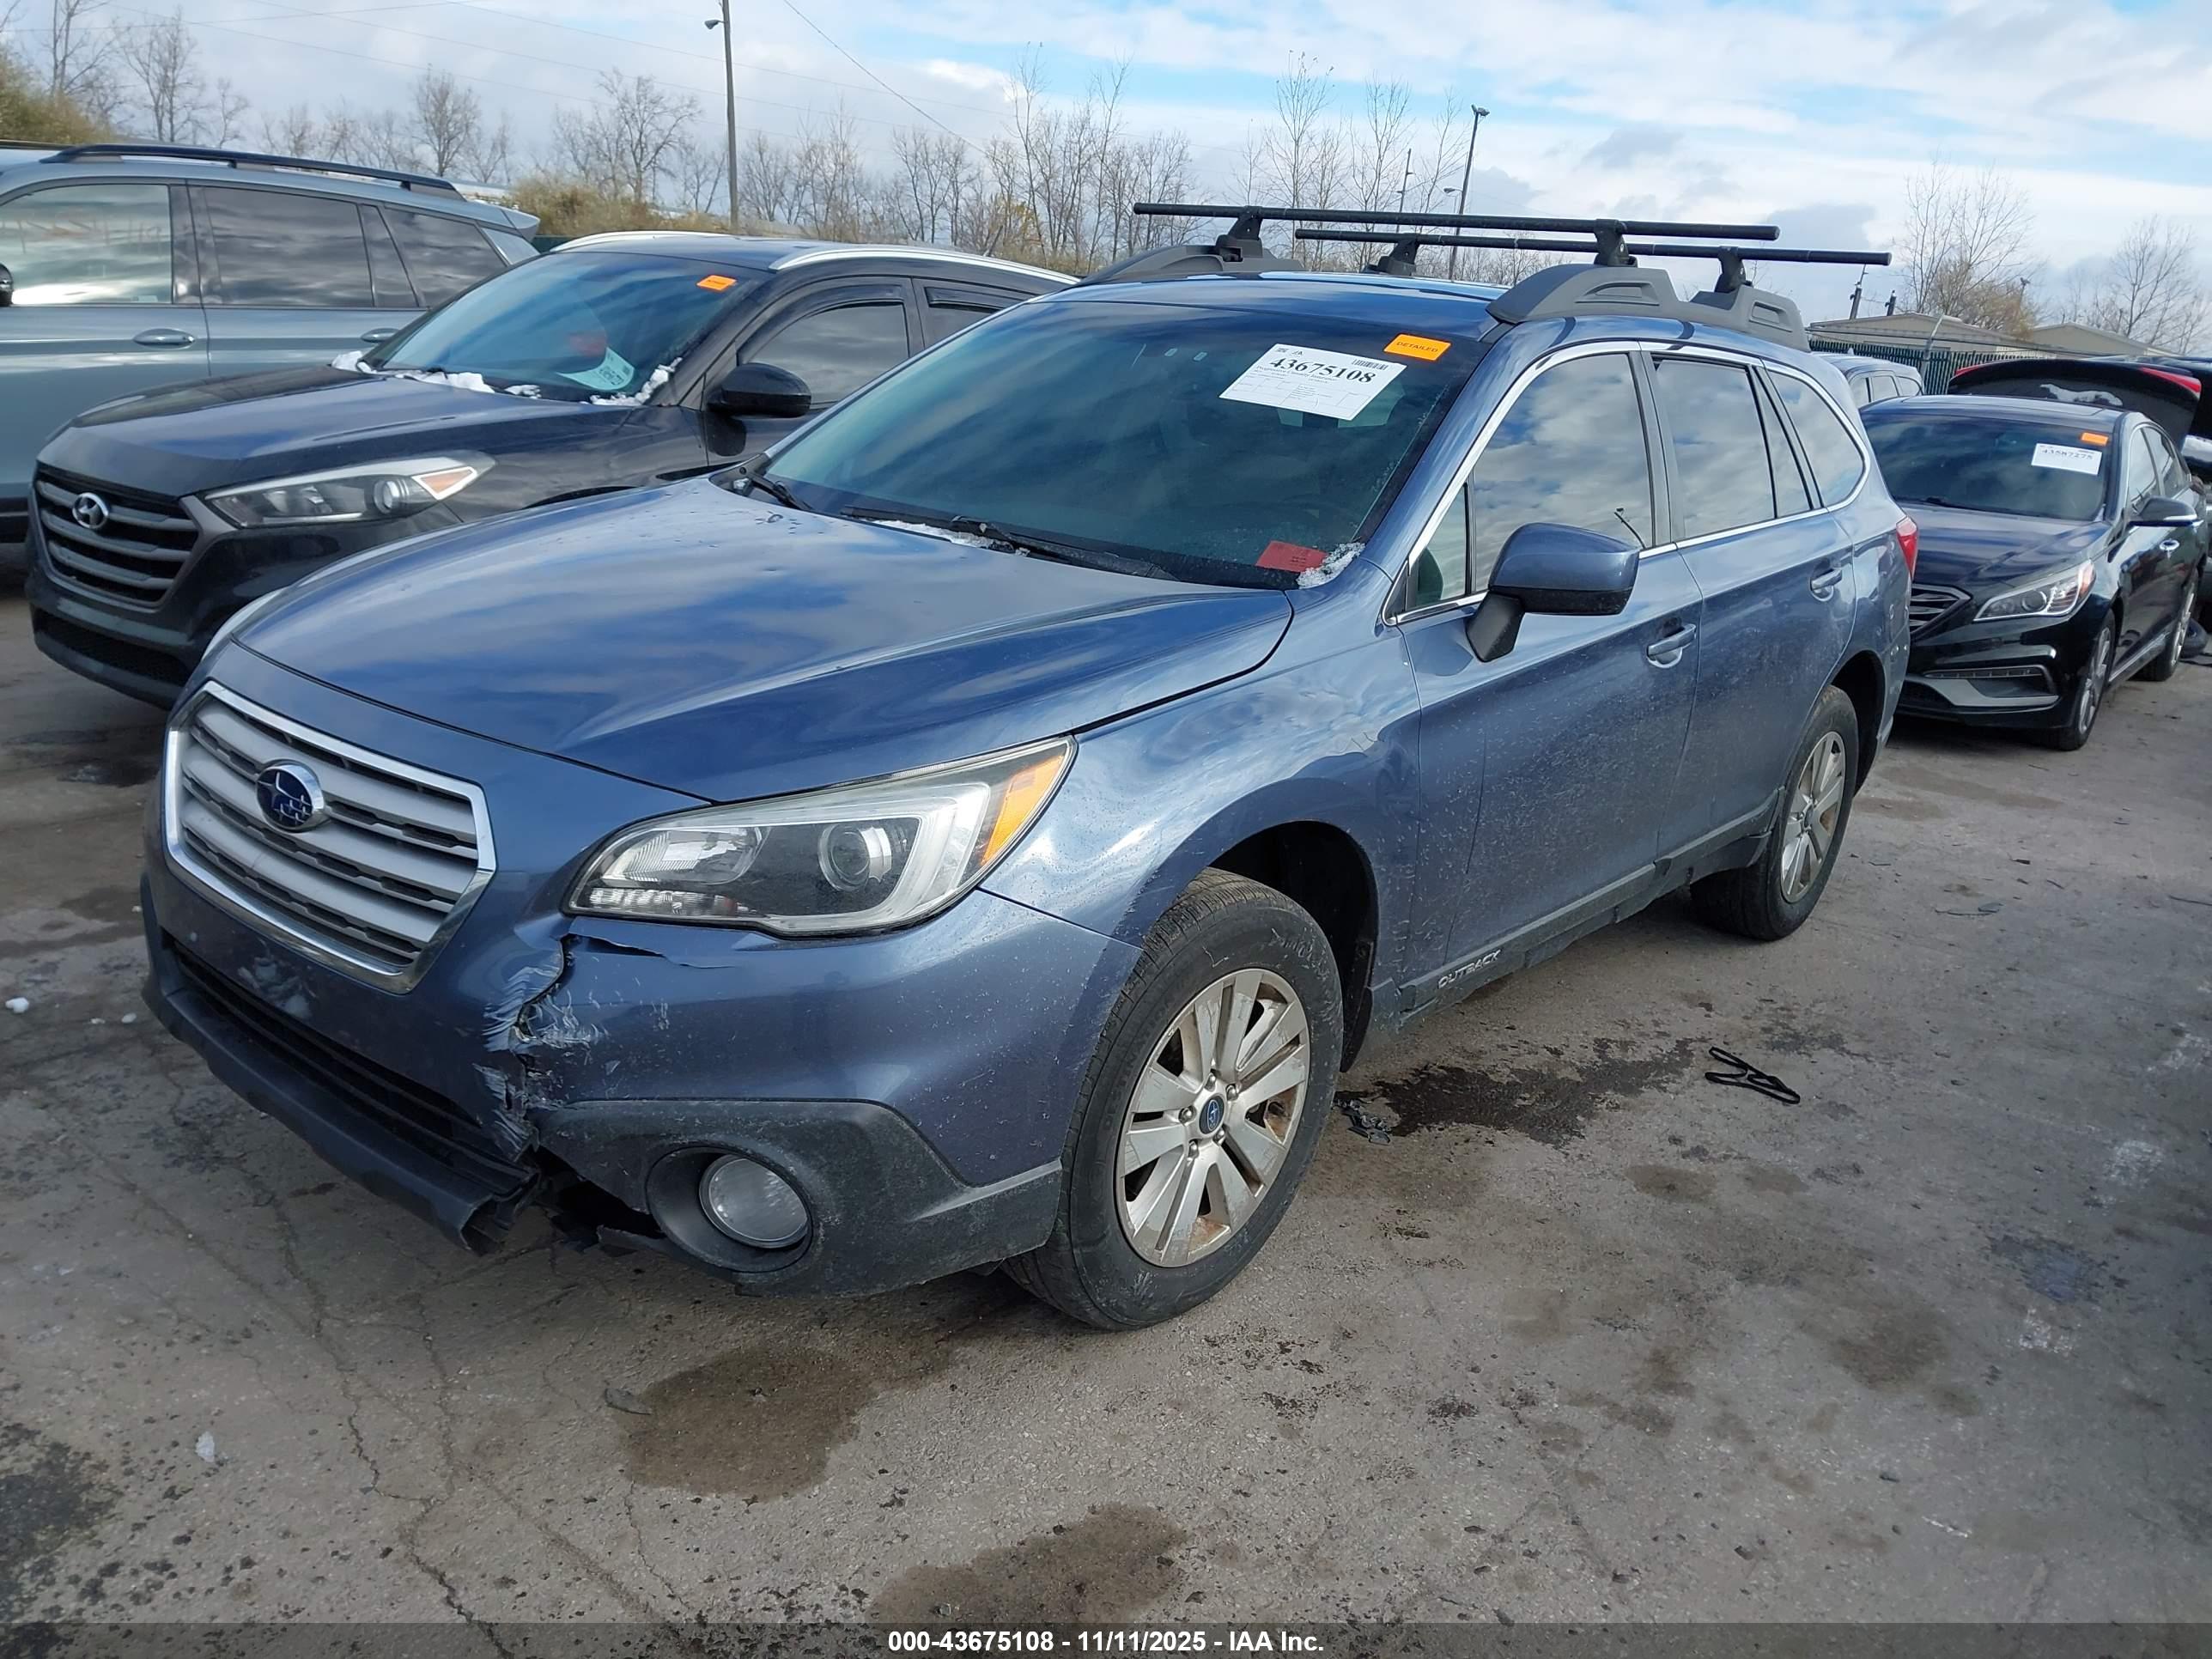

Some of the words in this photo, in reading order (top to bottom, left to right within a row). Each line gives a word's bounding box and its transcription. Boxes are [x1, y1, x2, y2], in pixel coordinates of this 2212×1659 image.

[1396, 341, 1438, 353] DETAILED
[1269, 357, 1376, 383] 43675108
[1437, 949, 1502, 989] OUTBACK
